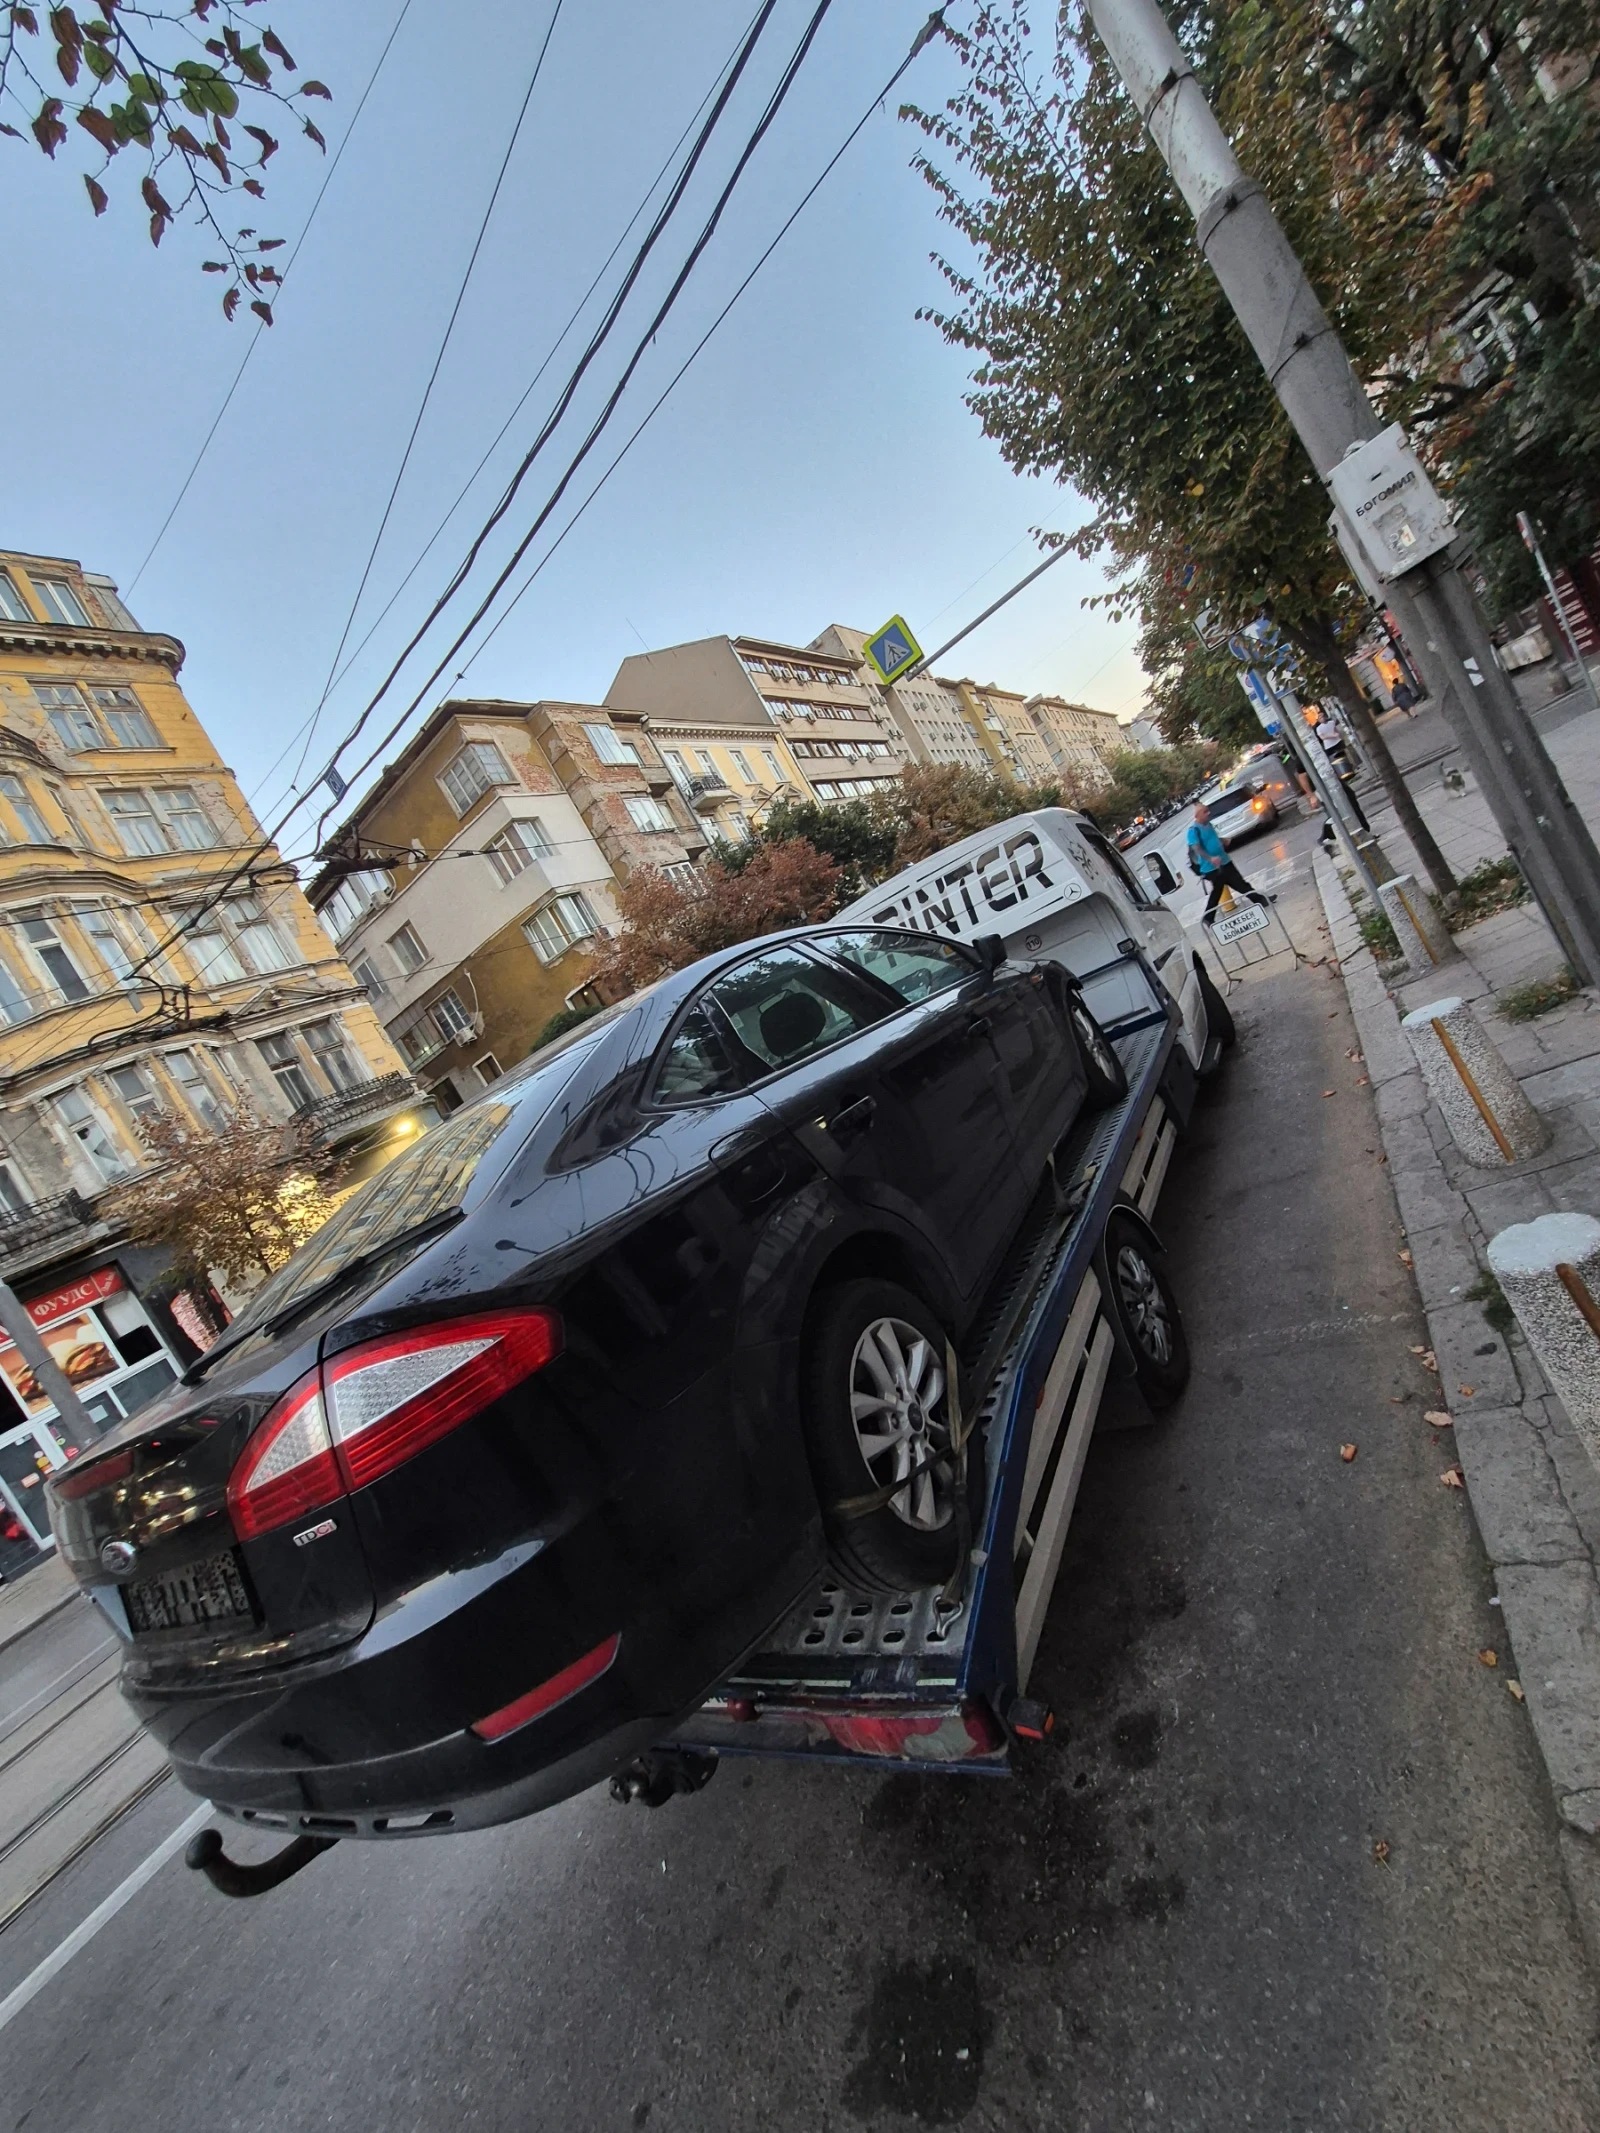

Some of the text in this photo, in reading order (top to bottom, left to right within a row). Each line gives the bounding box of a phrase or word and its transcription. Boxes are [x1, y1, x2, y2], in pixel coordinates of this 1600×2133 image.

[1355, 470, 1416, 517] БОГОМИЛ
[1223, 918, 1263, 941] АБОНАМЕНТ
[34, 1283, 94, 1316] ФУУДС
[295, 1521, 334, 1545] TDCi
